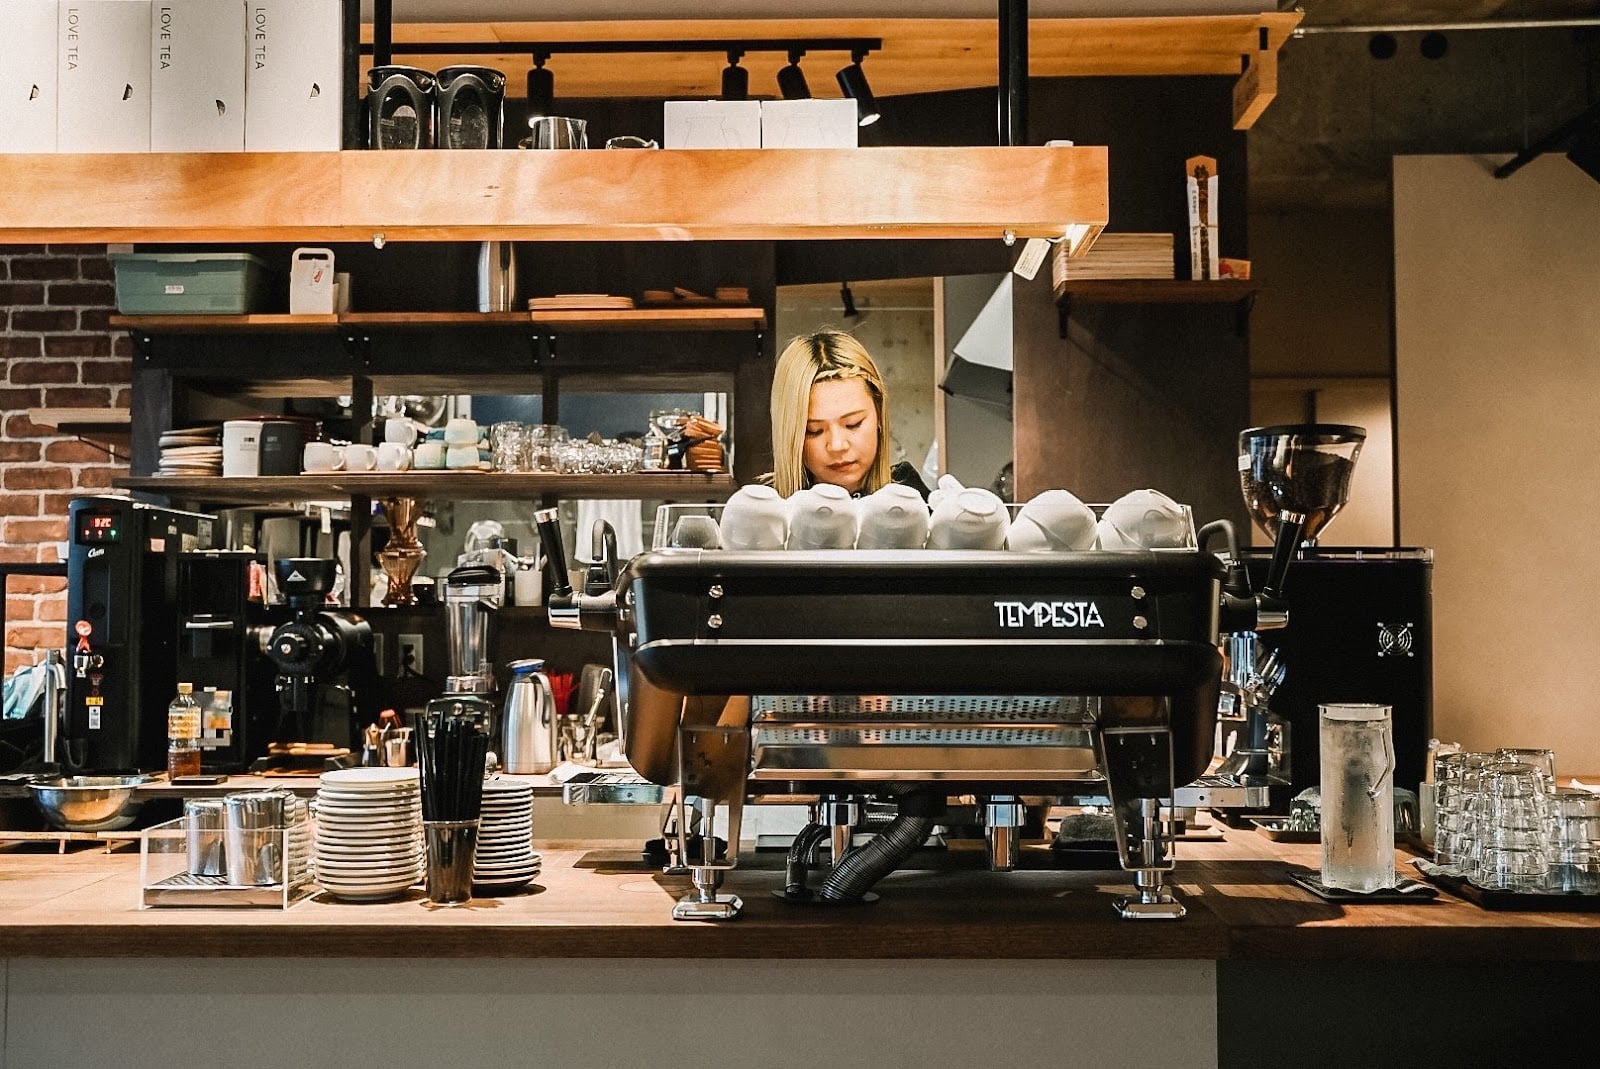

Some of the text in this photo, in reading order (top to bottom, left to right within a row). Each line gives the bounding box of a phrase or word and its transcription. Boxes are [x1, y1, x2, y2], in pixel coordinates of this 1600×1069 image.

[67, 8, 79, 70] LOVE TEA
[160, 7, 171, 70] LOVE TEA
[255, 7, 266, 70] LOVE TEA
[994, 601, 1105, 628] TEMPESTA
